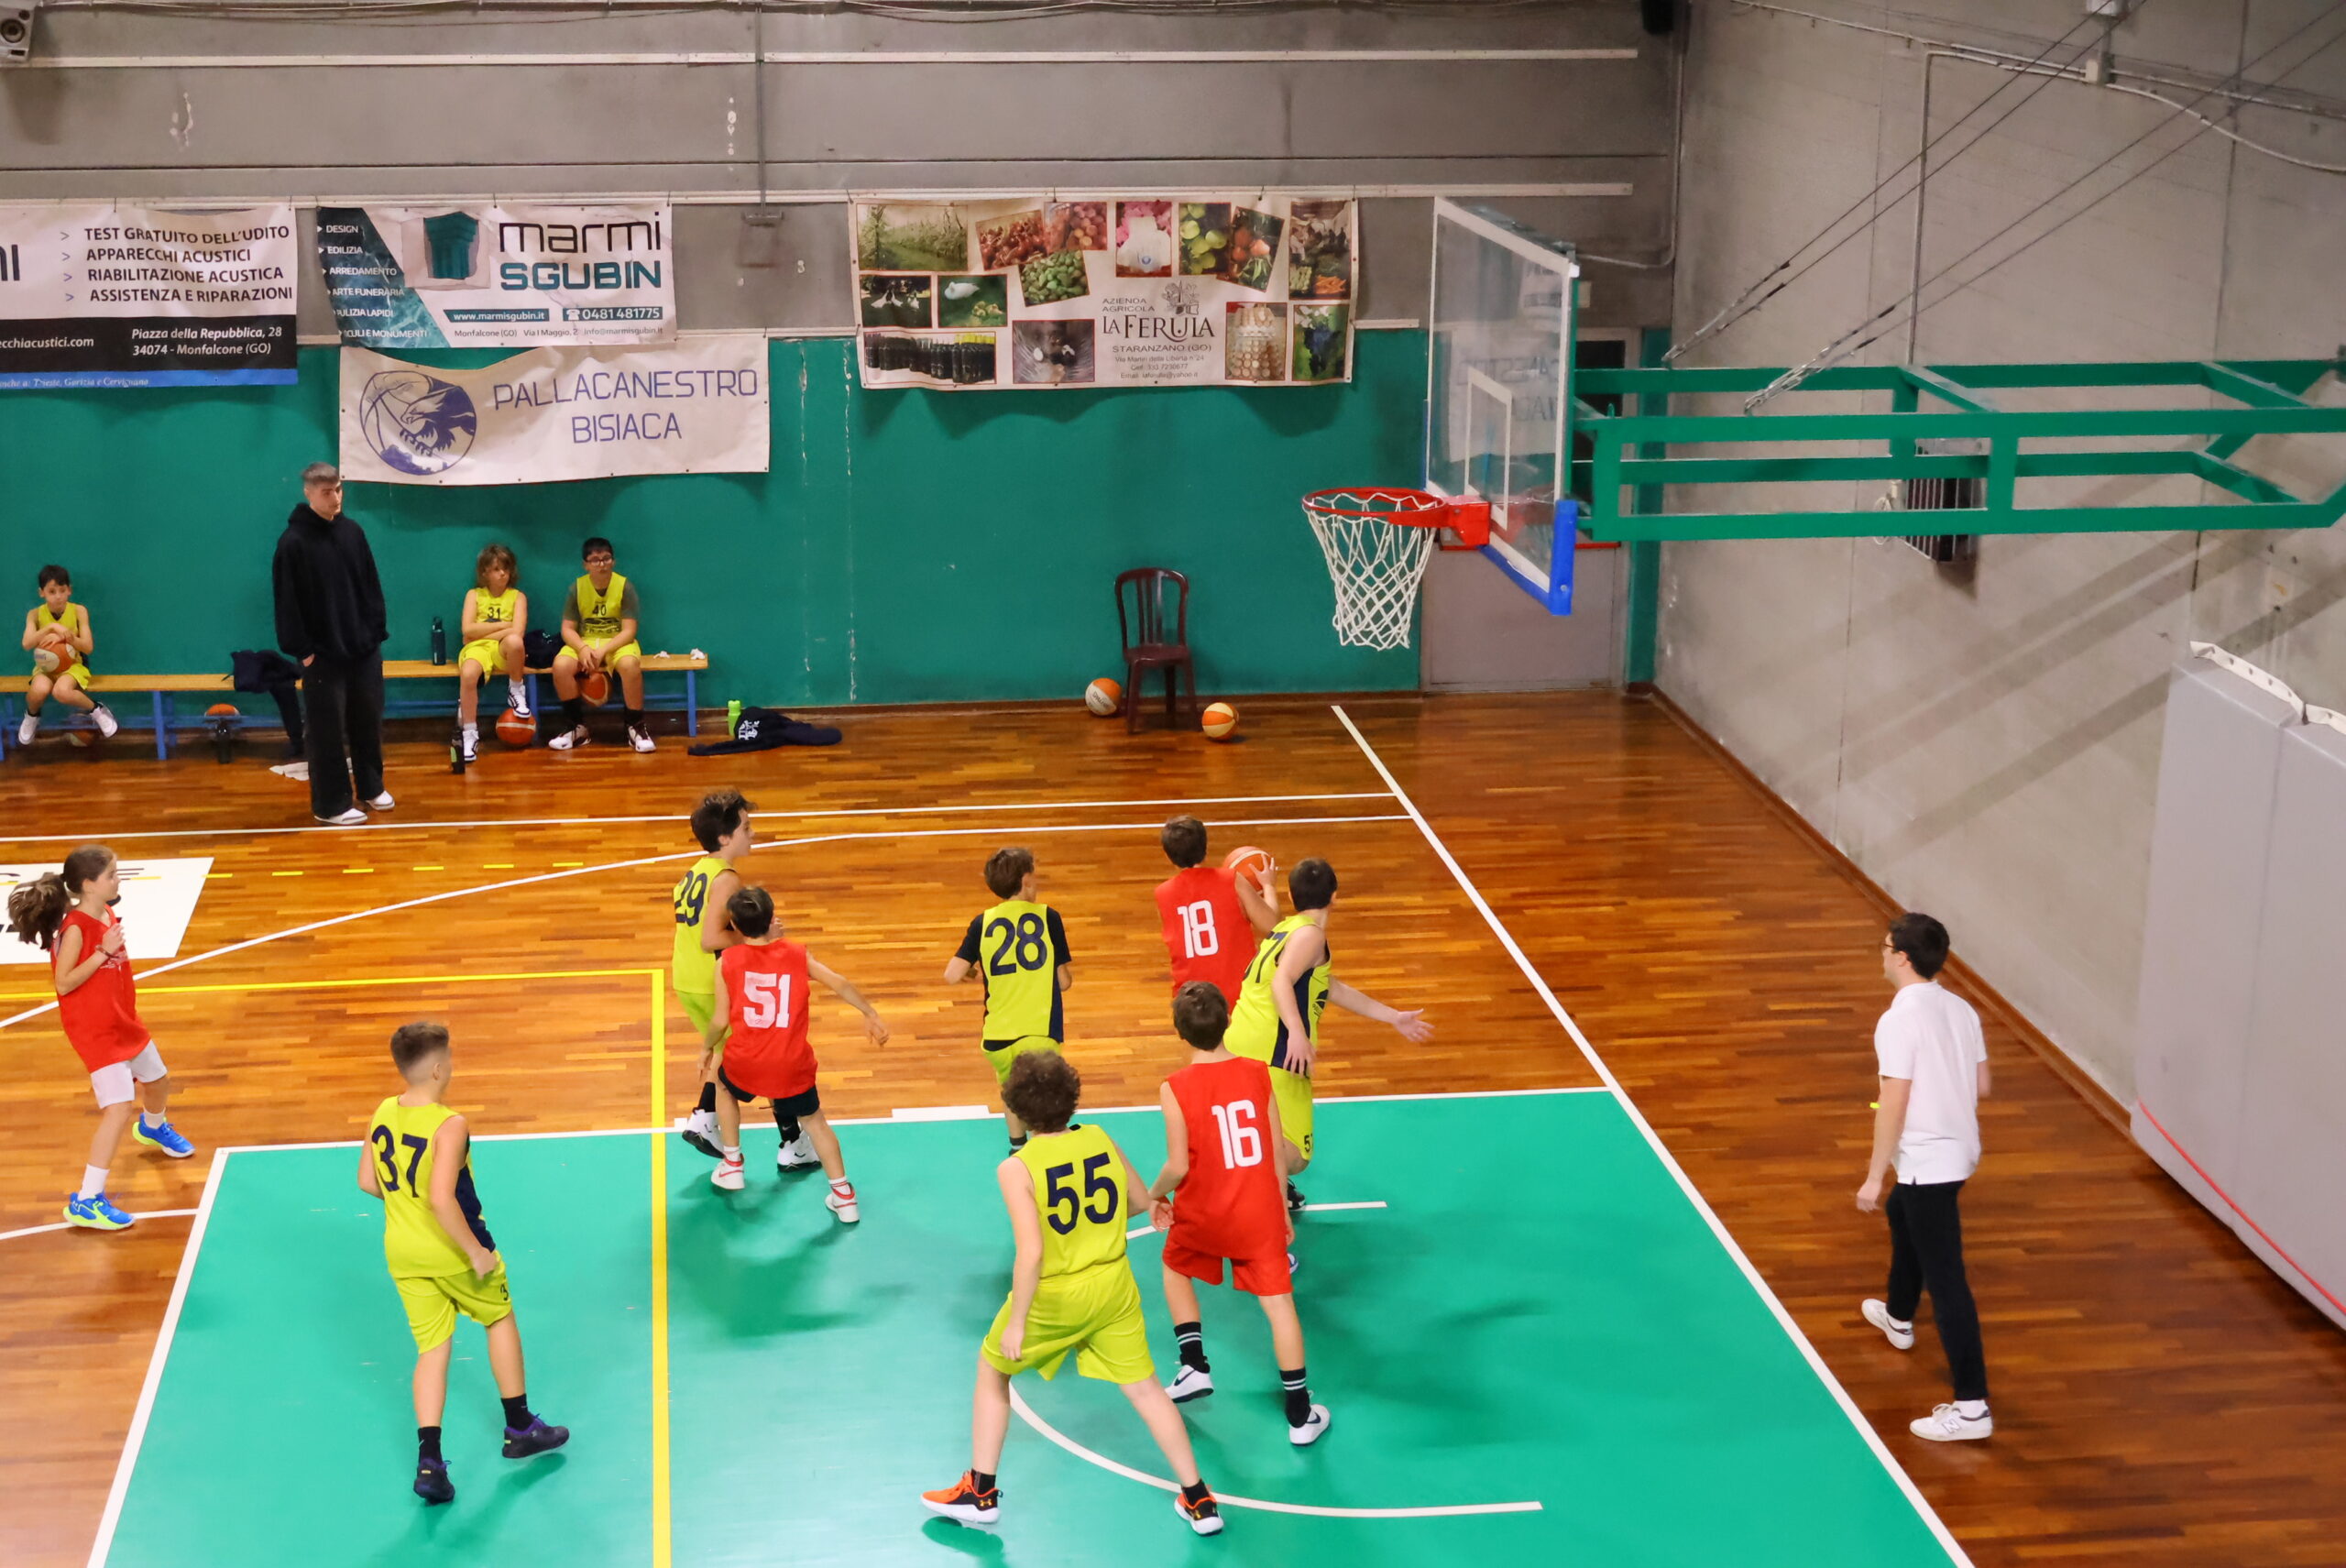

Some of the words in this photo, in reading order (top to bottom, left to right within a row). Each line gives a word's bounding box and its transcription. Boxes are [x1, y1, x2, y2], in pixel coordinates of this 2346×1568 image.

[84, 227, 120, 240] TEST
[125, 227, 198, 244] GRATUITO
[202, 225, 289, 245] DELL'UDITO
[326, 225, 358, 233] DESIGN
[499, 212, 661, 253] marmi
[86, 247, 178, 262] APPARECCHI
[182, 248, 250, 263] ACUSTICI
[327, 246, 363, 254] EDILIZIA
[88, 268, 203, 283] RIABILITAZIONE
[208, 267, 283, 283] ACUSTICA
[329, 267, 397, 276] ARREDAMENTO
[500, 260, 662, 291] SGUBIN
[90, 289, 181, 302] ASSISTENZA
[185, 289, 193, 302] E
[197, 287, 292, 302] RIPARAZIONI
[332, 288, 354, 296] ARTE
[355, 288, 404, 297] FUNERARIA
[454, 312, 544, 322] www.marmisgubin.it
[582, 308, 614, 319] 0481
[616, 307, 660, 319] 481775
[132, 328, 169, 339] Piazza
[170, 328, 198, 339] della
[200, 326, 266, 341] Repubblica,
[268, 326, 282, 337] 28
[372, 329, 427, 338] MONUMENTI
[455, 329, 499, 337] Monfalcone
[500, 330, 517, 338] (GO)
[133, 344, 168, 356] 34074
[176, 344, 243, 355] Monfalcone
[246, 343, 271, 356] (GO)
[1113, 345, 1185, 353] STARANZANO
[1188, 344, 1211, 352] (GO)
[493, 369, 758, 411] PALLACANESTRO
[572, 412, 682, 444] BISIACA
[488, 606, 500, 620] 31
[674, 870, 708, 927] 29
[1177, 899, 1219, 959] 18
[984, 913, 1047, 976] 28
[742, 970, 792, 1029] 51
[1211, 1099, 1264, 1170] 16
[371, 1124, 428, 1199] 37
[1046, 1152, 1119, 1235] 55
